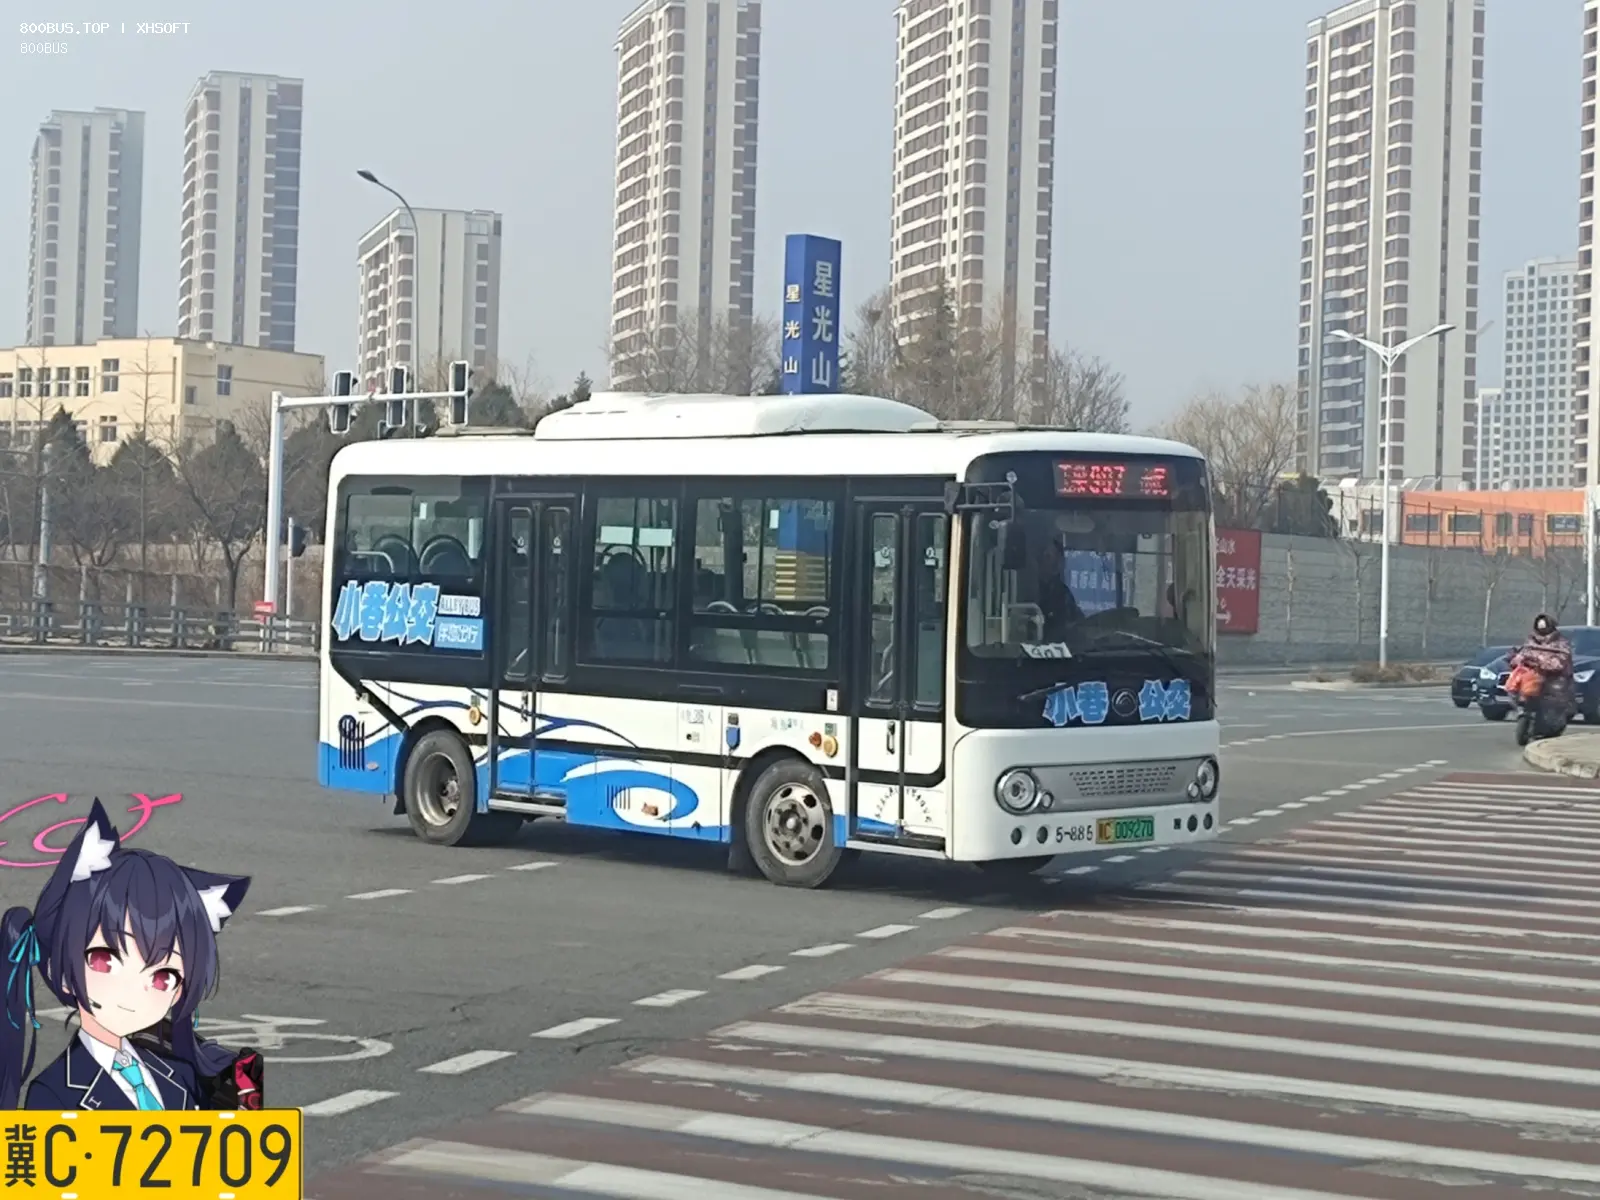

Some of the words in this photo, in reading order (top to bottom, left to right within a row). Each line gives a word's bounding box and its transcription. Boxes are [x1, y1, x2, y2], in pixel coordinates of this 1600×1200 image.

[784, 284, 800, 374] 星光山
[812, 260, 834, 388] 星光山
[331, 580, 440, 646] 小巷公交
[1042, 681, 1109, 727] 小巷
[1138, 678, 1192, 722] 公交
